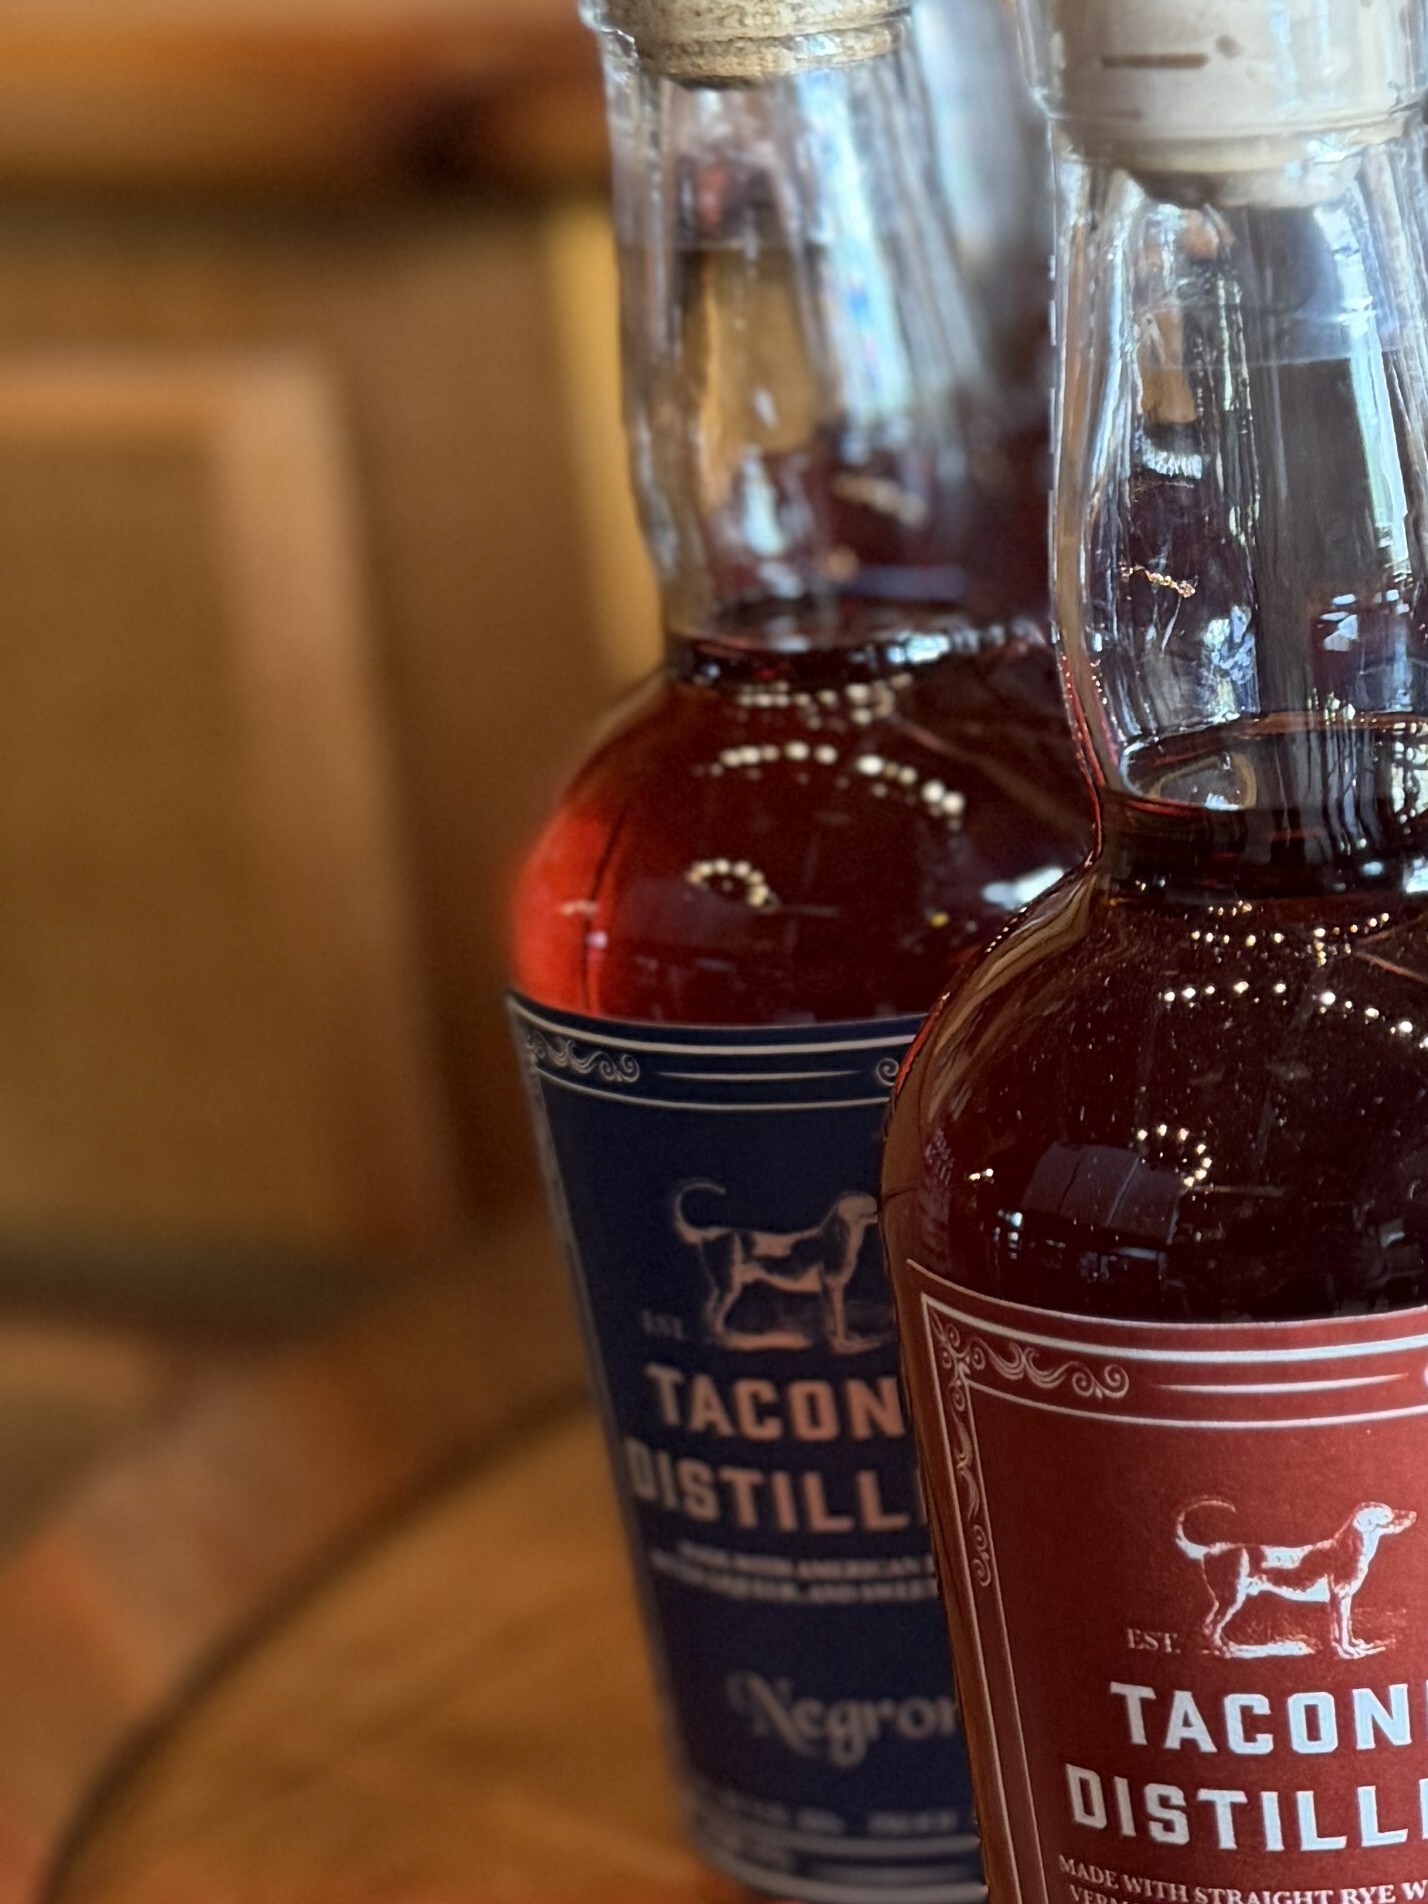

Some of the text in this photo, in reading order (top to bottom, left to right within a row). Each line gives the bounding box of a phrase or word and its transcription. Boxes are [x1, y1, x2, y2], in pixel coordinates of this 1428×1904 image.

[646, 1362, 905, 1441] TACON
[622, 1436, 926, 1532] DISTILL
[1127, 1628, 1180, 1654] EST.
[1058, 1853, 1119, 1889] MADE
